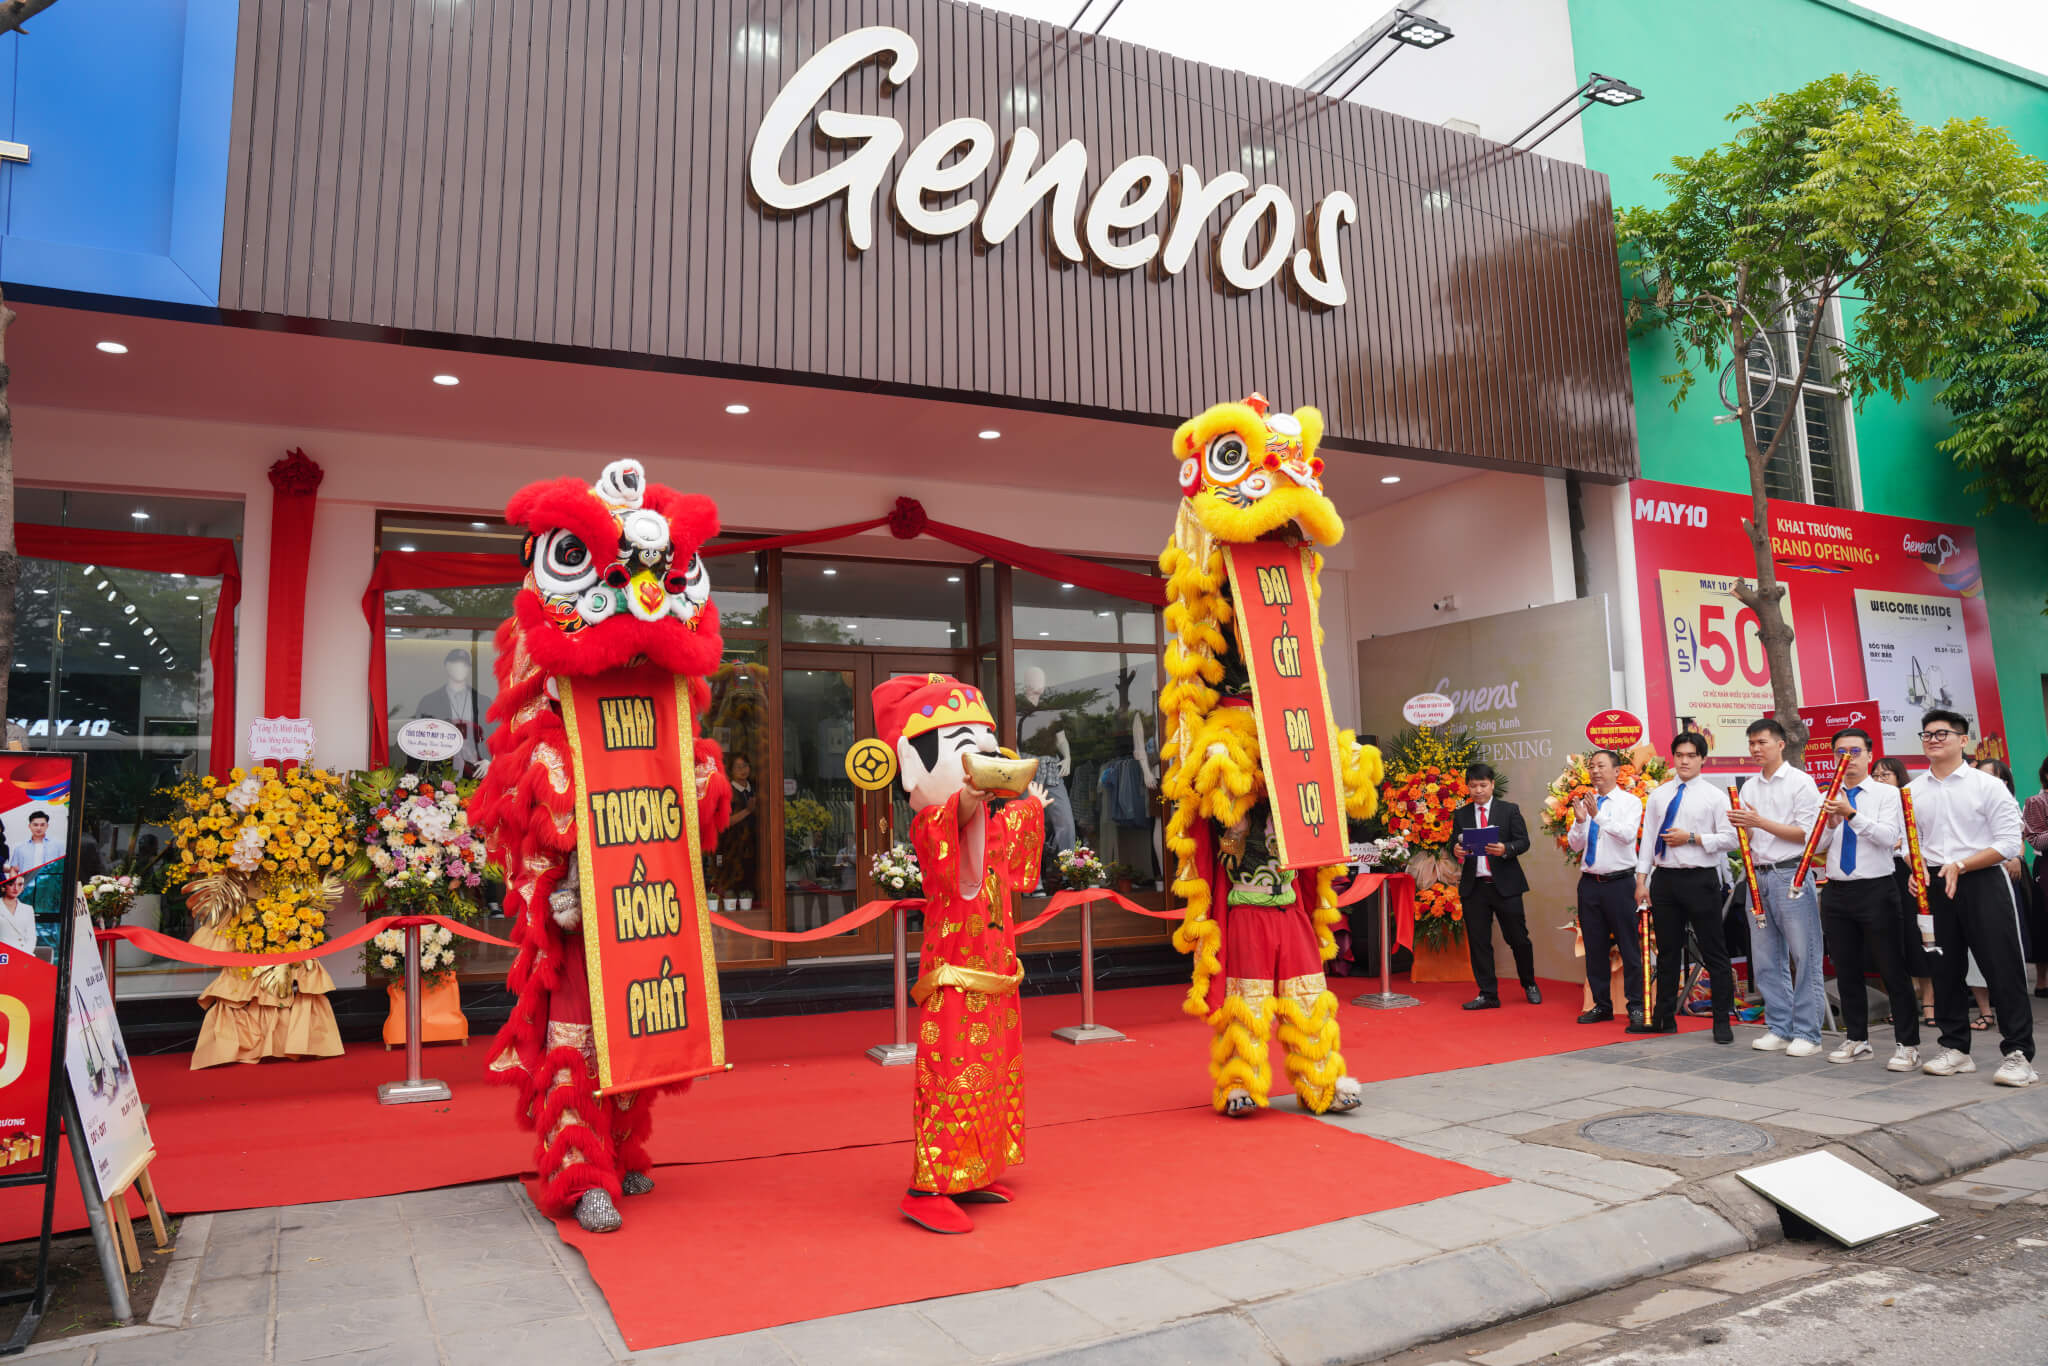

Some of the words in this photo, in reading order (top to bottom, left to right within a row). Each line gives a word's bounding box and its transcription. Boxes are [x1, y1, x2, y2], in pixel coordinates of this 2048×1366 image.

[749, 25, 1357, 306] Generos
[1776, 518, 1805, 535] KHAI
[1806, 521, 1854, 541] TRƯƠNG
[1768, 536, 1812, 558] RAND
[1814, 542, 1873, 564] OPENING
[1903, 533, 1937, 555] Generos
[1699, 579, 1716, 590] MAY
[1718, 581, 1727, 591] 10
[1870, 600, 1919, 615] WELCOME
[1921, 604, 1952, 618] INSIDE
[1673, 616, 1688, 641] TO
[1272, 620, 1303, 678] CÁT
[1699, 604, 1772, 688] 50
[1678, 649, 1691, 673] UP
[78, 718, 110, 737] 10
[598, 695, 657, 751] KHAI
[1476, 738, 1553, 762] PENING
[589, 785, 683, 848] TRƯƠNG
[613, 853, 682, 942] HỒNG
[627, 955, 688, 1038] PHÁT
